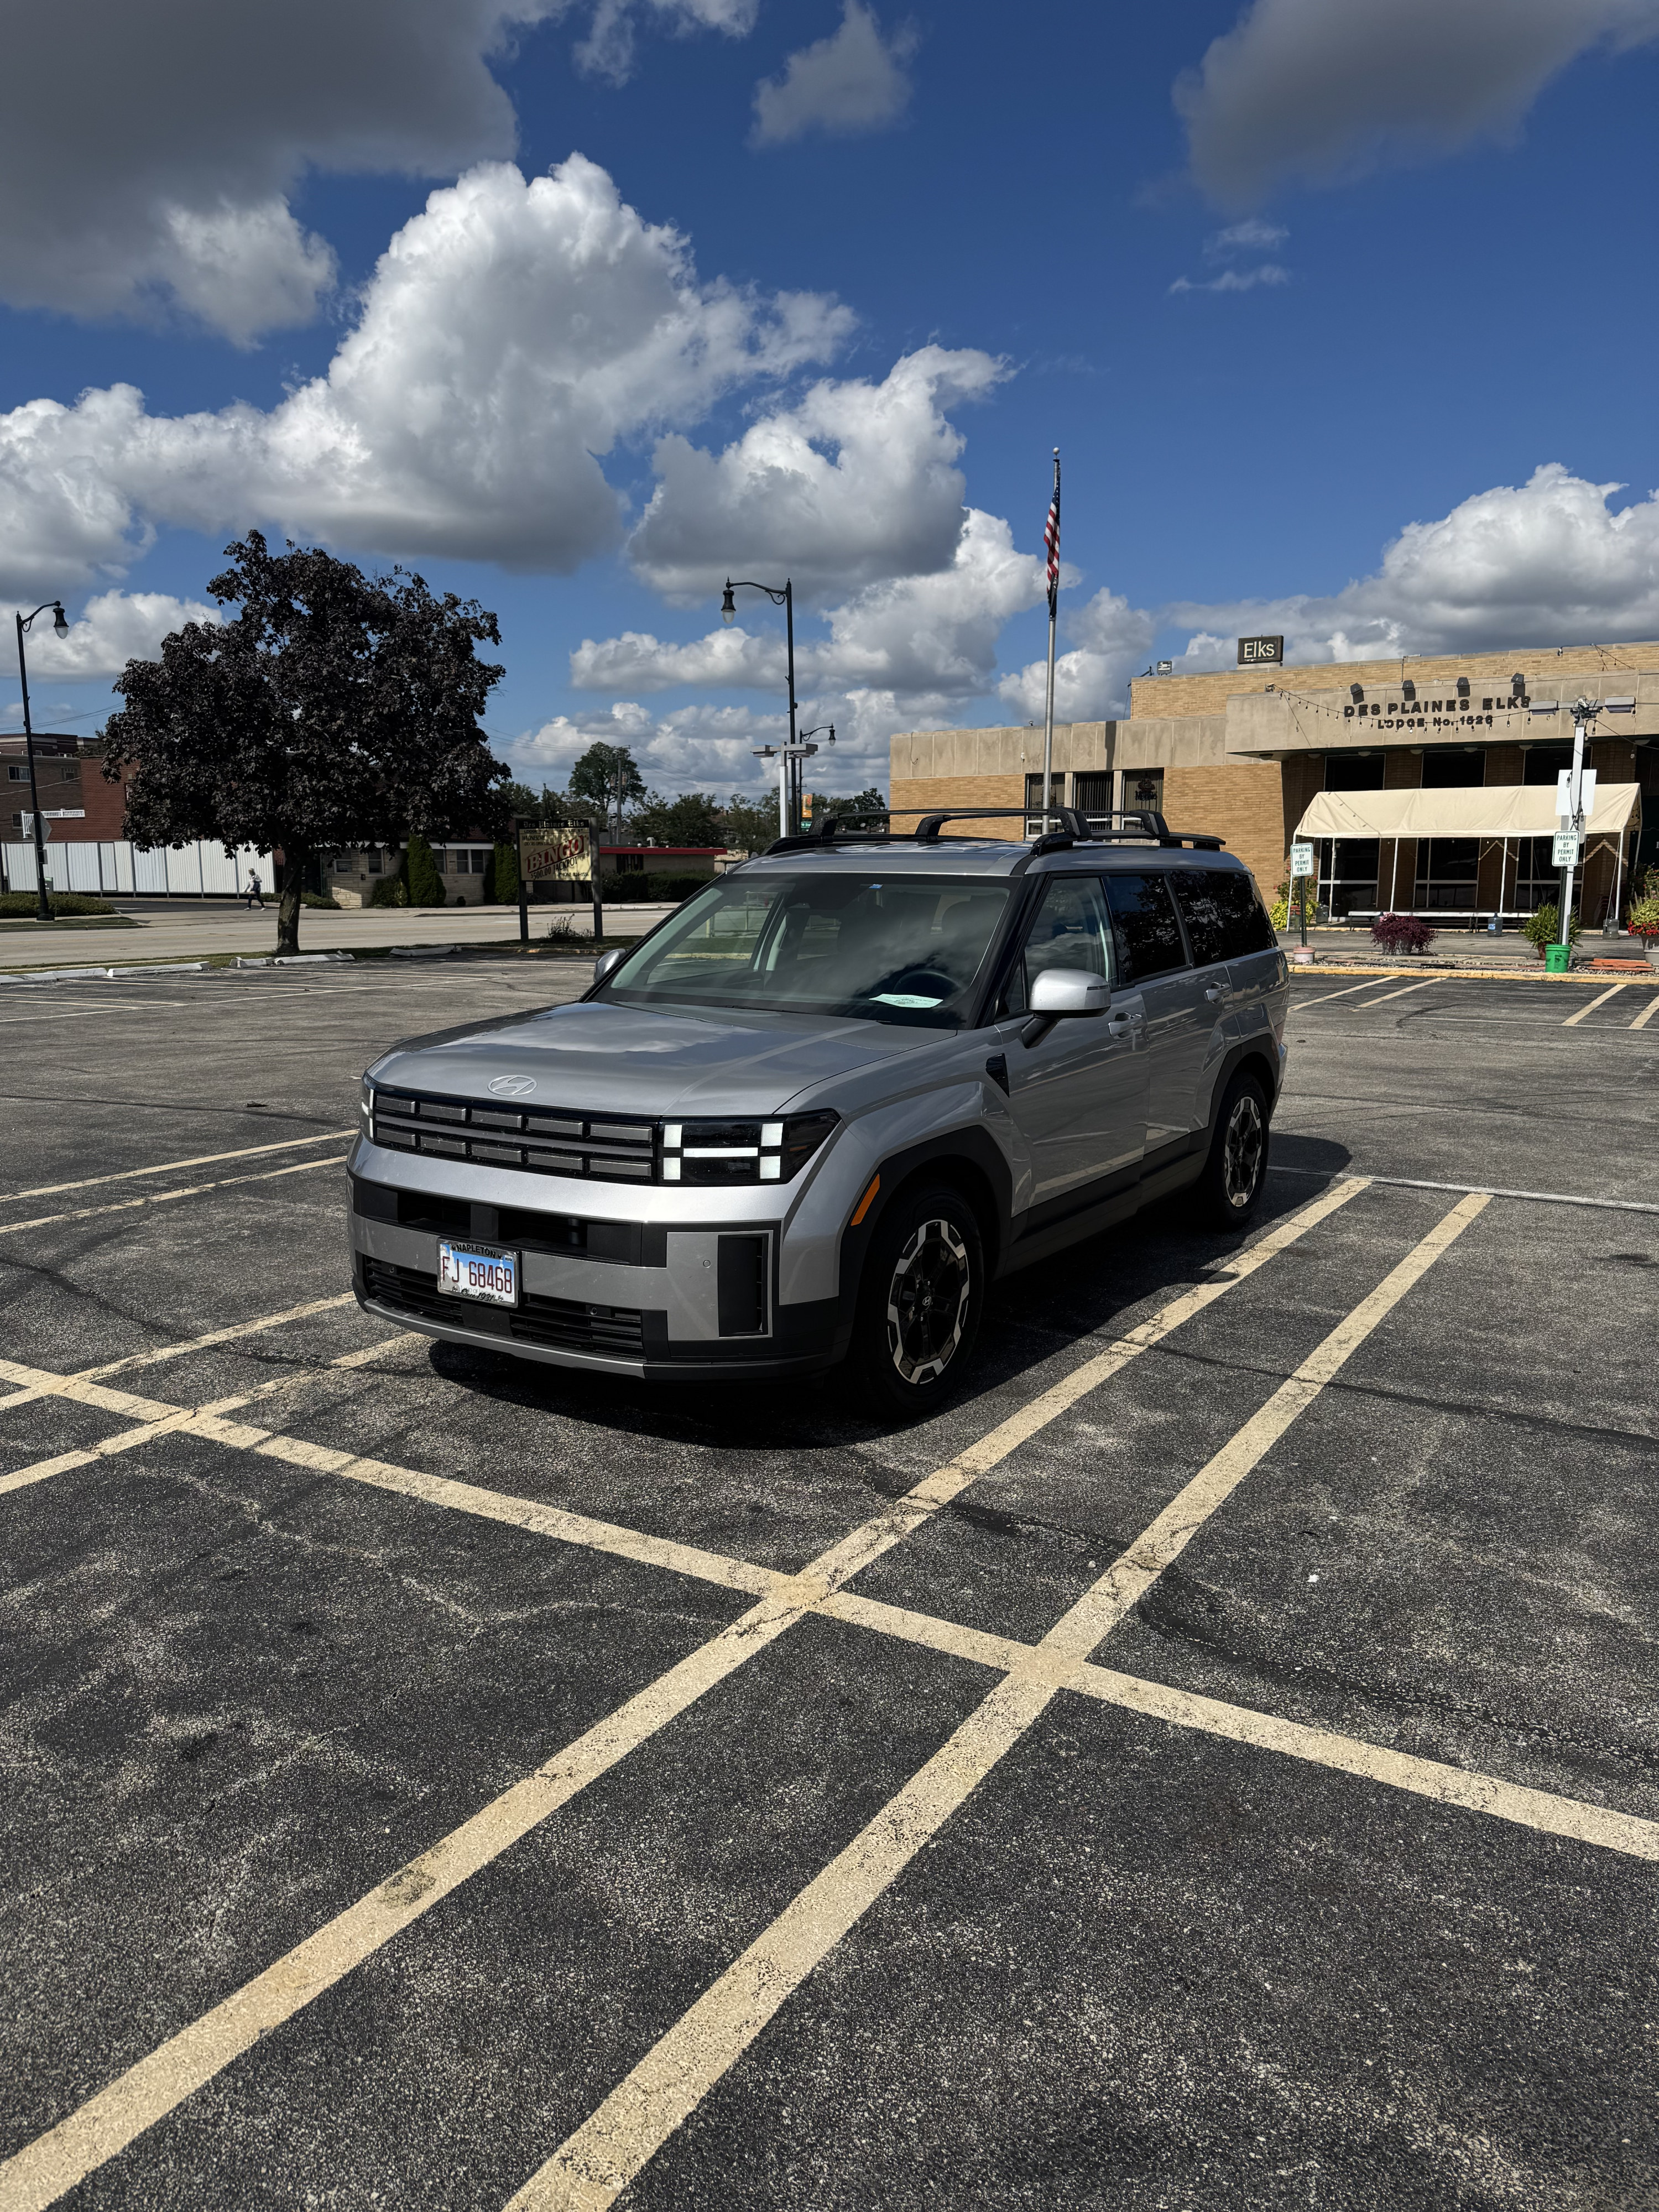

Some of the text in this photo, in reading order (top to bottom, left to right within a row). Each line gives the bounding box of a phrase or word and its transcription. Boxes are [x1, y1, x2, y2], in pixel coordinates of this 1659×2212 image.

[1244, 641, 1275, 658] Elks
[1344, 696, 1531, 717] DES PLAINES ELKS
[1378, 715, 1493, 729] LODGE No. 1526
[528, 836, 583, 873] BINGO
[531, 867, 551, 880] $500.00
[553, 856, 577, 874] JACKPOT
[456, 1244, 496, 1258] NAPLETON
[442, 1256, 512, 1293] FJ 68468
[460, 1288, 476, 1298] Since
